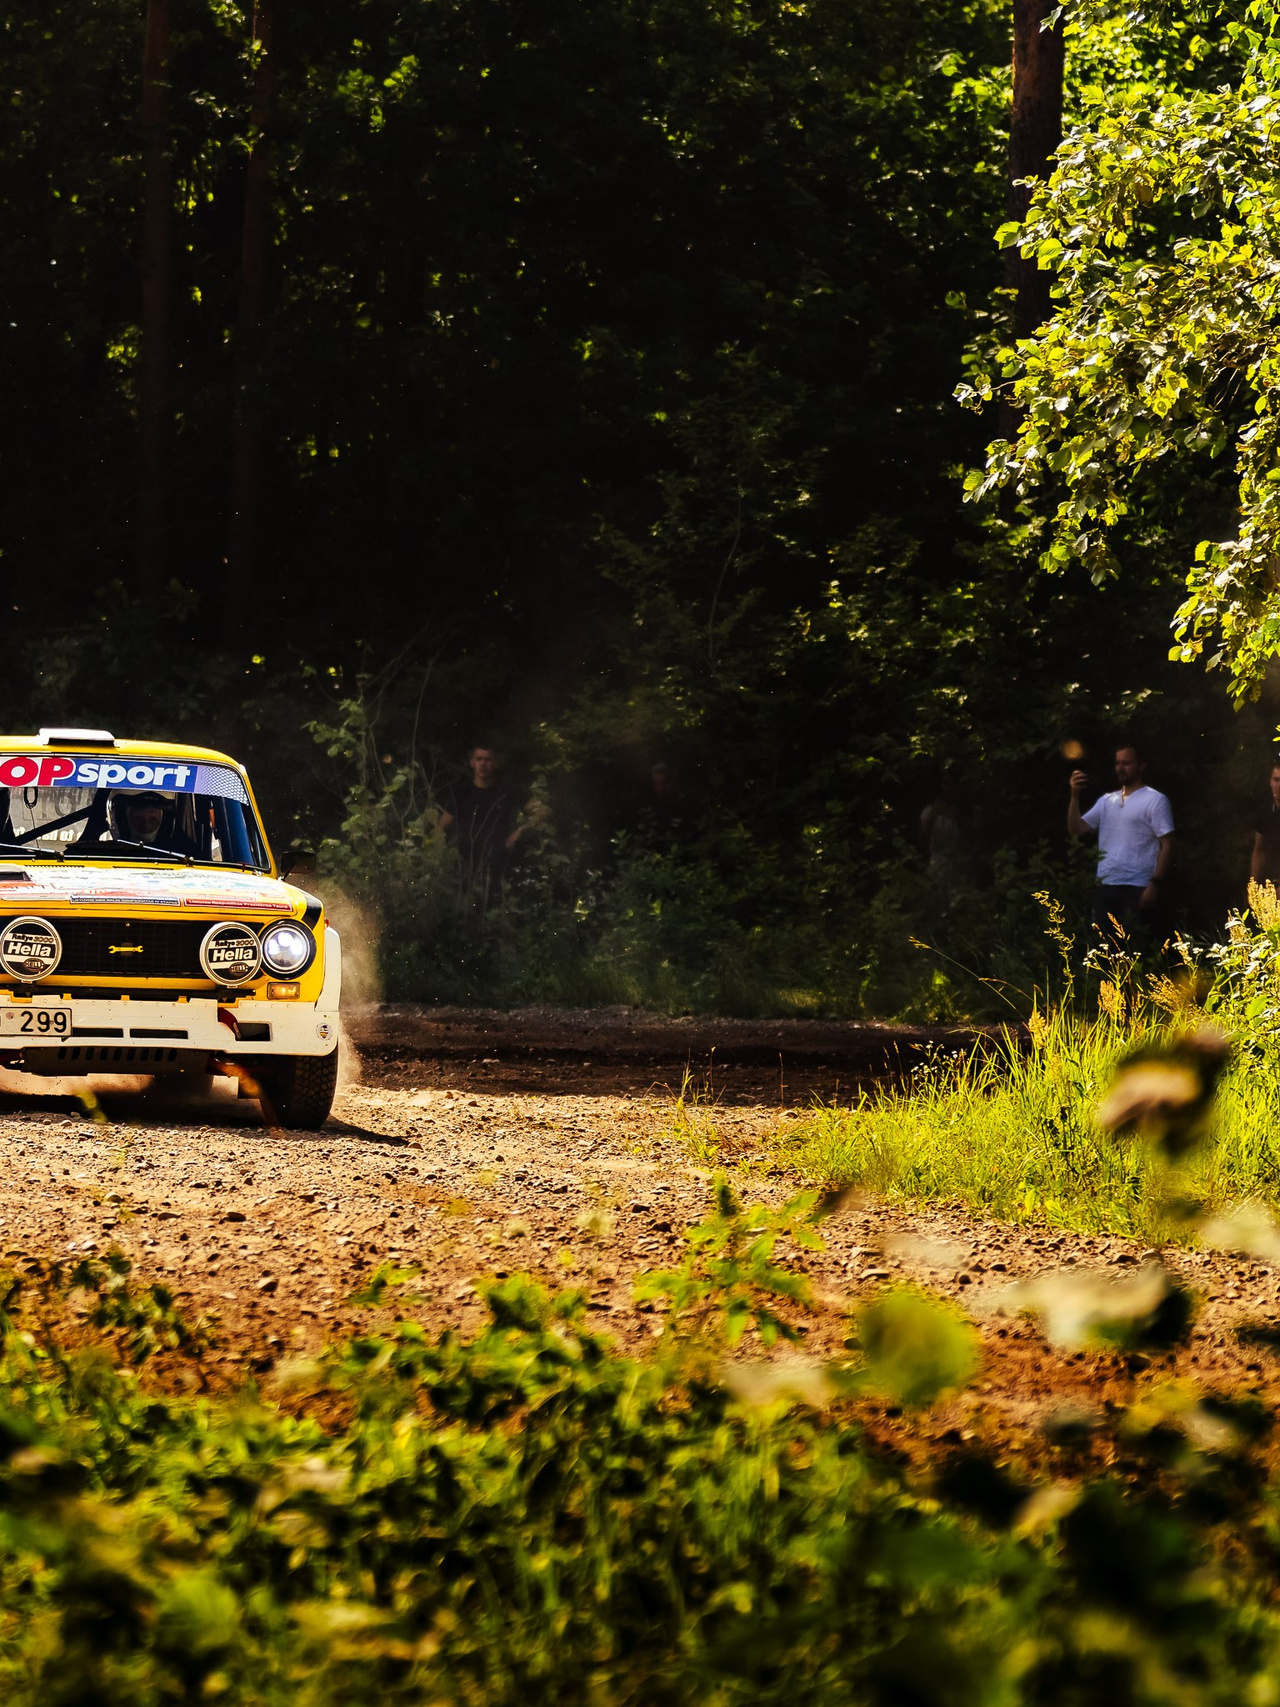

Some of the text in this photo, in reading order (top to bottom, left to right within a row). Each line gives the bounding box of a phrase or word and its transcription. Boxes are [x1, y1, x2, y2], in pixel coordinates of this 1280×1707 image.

[11, 933, 33, 941] Rallye
[8, 942, 51, 957] Hella
[215, 940, 235, 948] Rallye
[213, 948, 253, 961] Hella
[20, 1011, 67, 1033] 299
